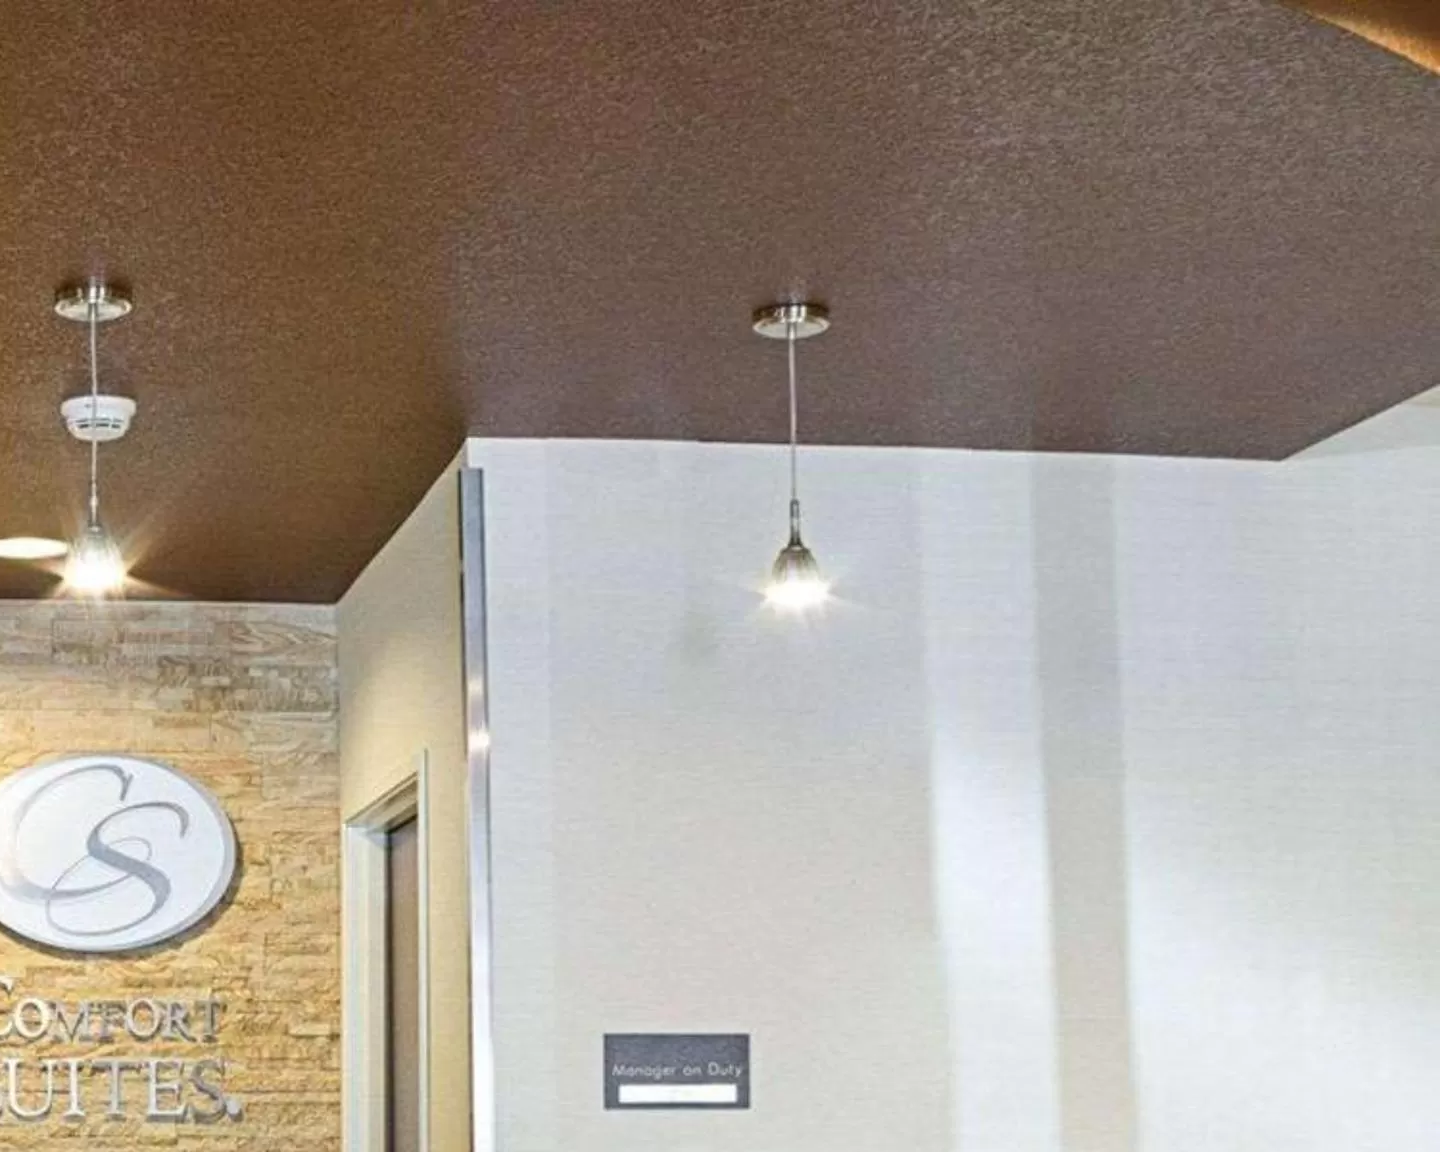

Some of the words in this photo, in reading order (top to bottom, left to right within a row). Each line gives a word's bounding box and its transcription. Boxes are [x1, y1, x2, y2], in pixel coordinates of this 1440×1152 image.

[611, 1063, 676, 1080] Manager
[682, 1065, 702, 1077] on
[707, 1061, 744, 1078] Duty
